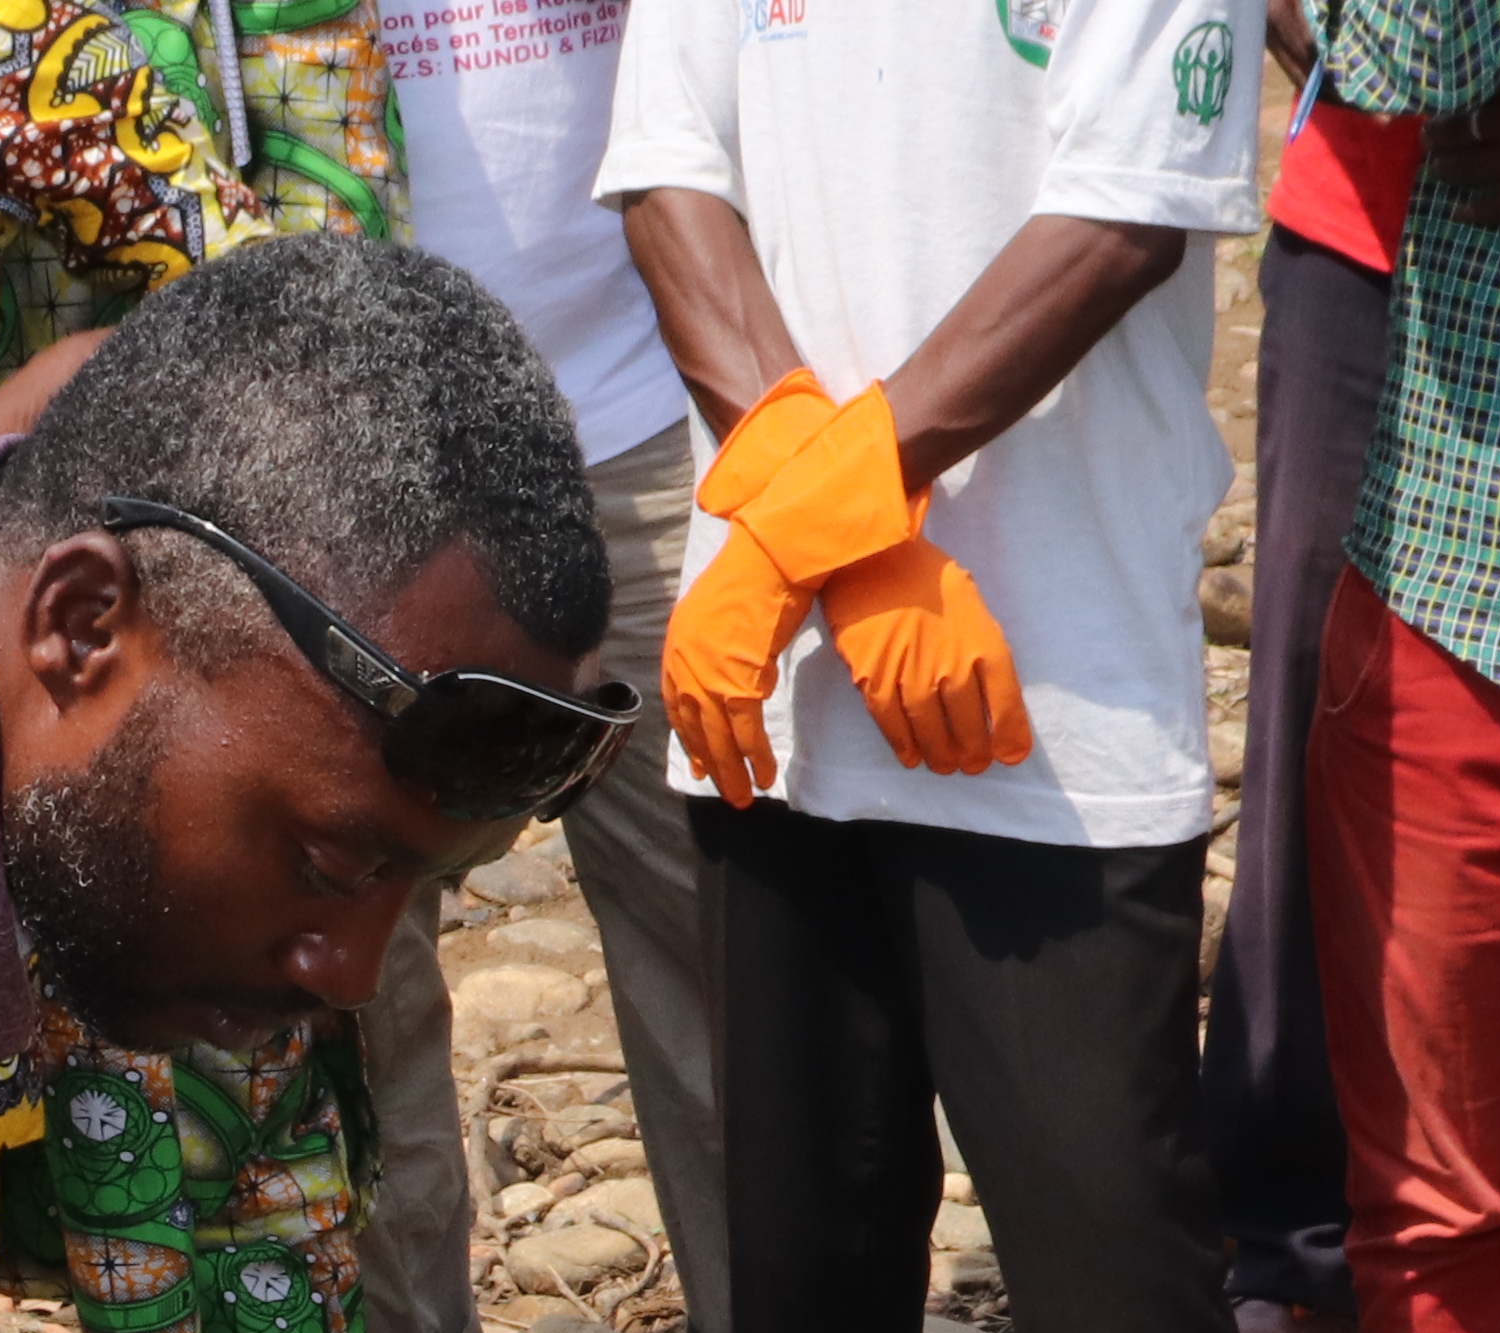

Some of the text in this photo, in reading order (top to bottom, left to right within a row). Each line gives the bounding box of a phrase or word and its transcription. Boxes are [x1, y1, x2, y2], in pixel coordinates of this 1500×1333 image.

[383, 14, 415, 31] on
[424, 4, 484, 30] pour
[492, 0, 528, 16] les
[449, 31, 481, 49] en
[488, 11, 591, 43] Territoire
[597, 3, 617, 21] de
[453, 41, 549, 73] NUNDU
[560, 36, 574, 54] &
